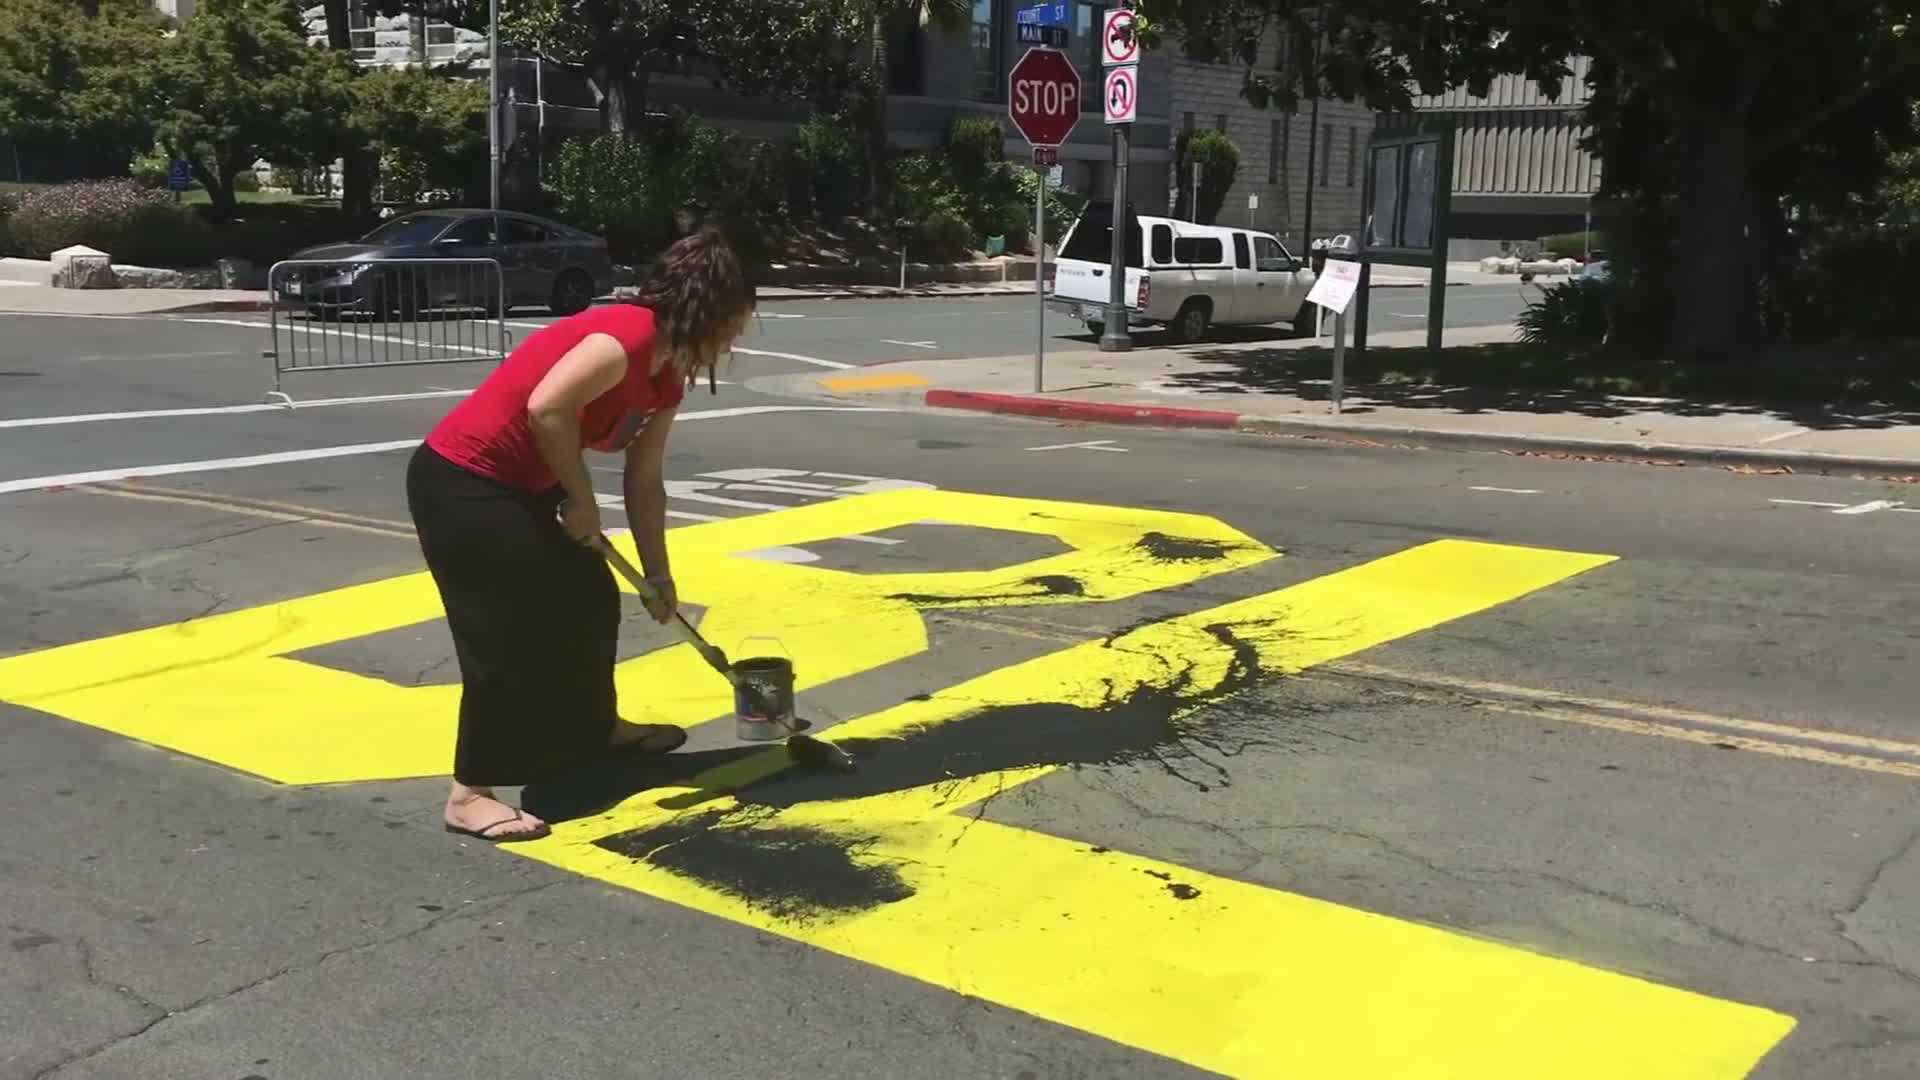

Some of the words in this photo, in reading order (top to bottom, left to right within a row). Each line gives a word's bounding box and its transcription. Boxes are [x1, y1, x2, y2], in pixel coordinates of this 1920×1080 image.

[1016, 8, 1040, 24] COURT
[1055, 5, 1065, 21] ST
[1021, 27, 1042, 41] MAIN
[1015, 79, 1076, 116] STOP
